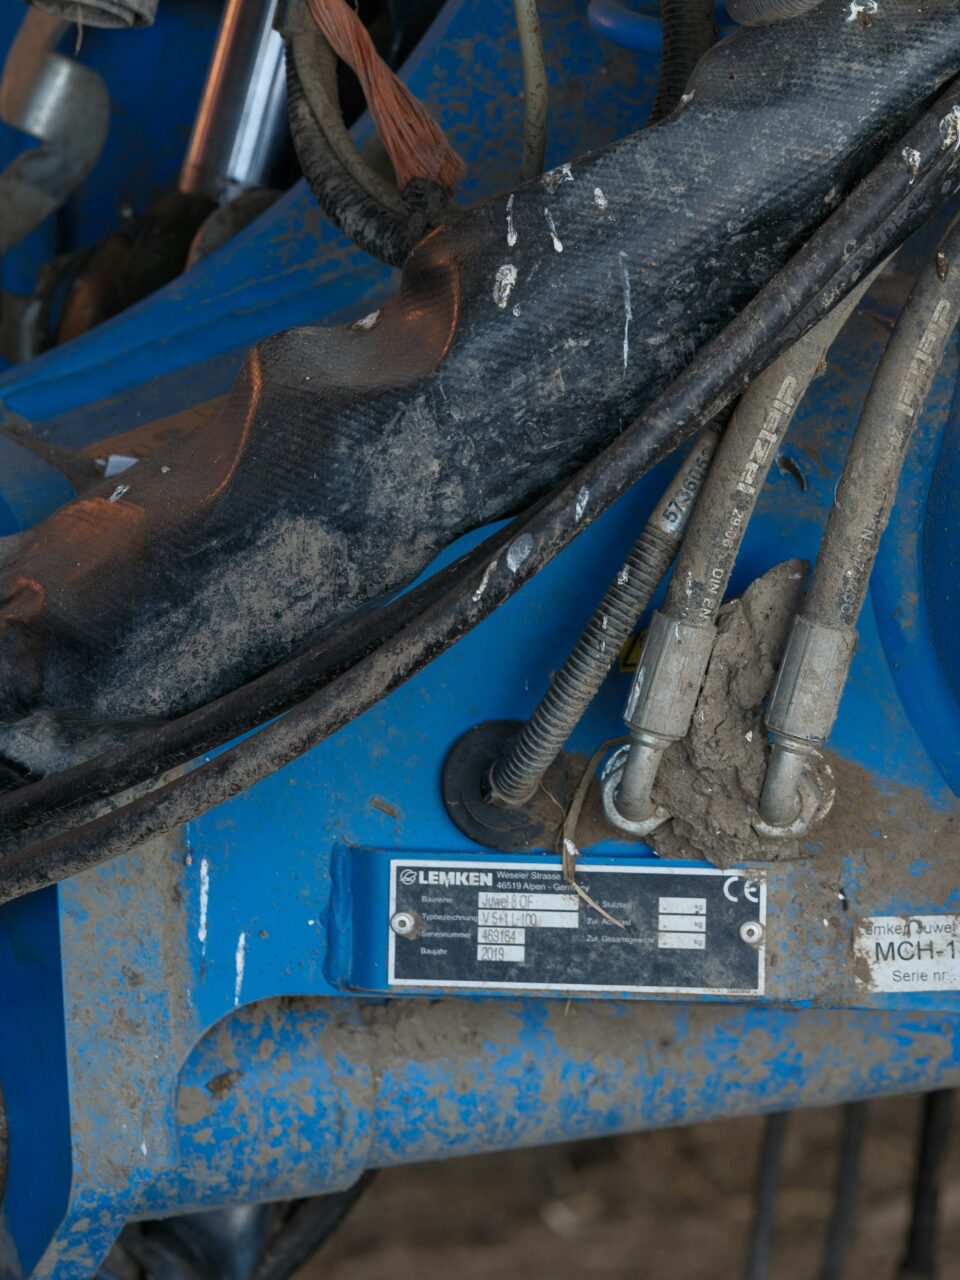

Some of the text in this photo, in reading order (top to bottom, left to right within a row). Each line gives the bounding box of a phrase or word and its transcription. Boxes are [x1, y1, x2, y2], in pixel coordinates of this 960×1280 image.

[419, 871, 493, 886] LEMKEN
[497, 872, 561, 881] Weseler Strasse
[497, 882, 521, 890] 46519
[523, 883, 546, 892] Alpen
[482, 948, 504, 961] 2019
[892, 970, 928, 982] Serie
